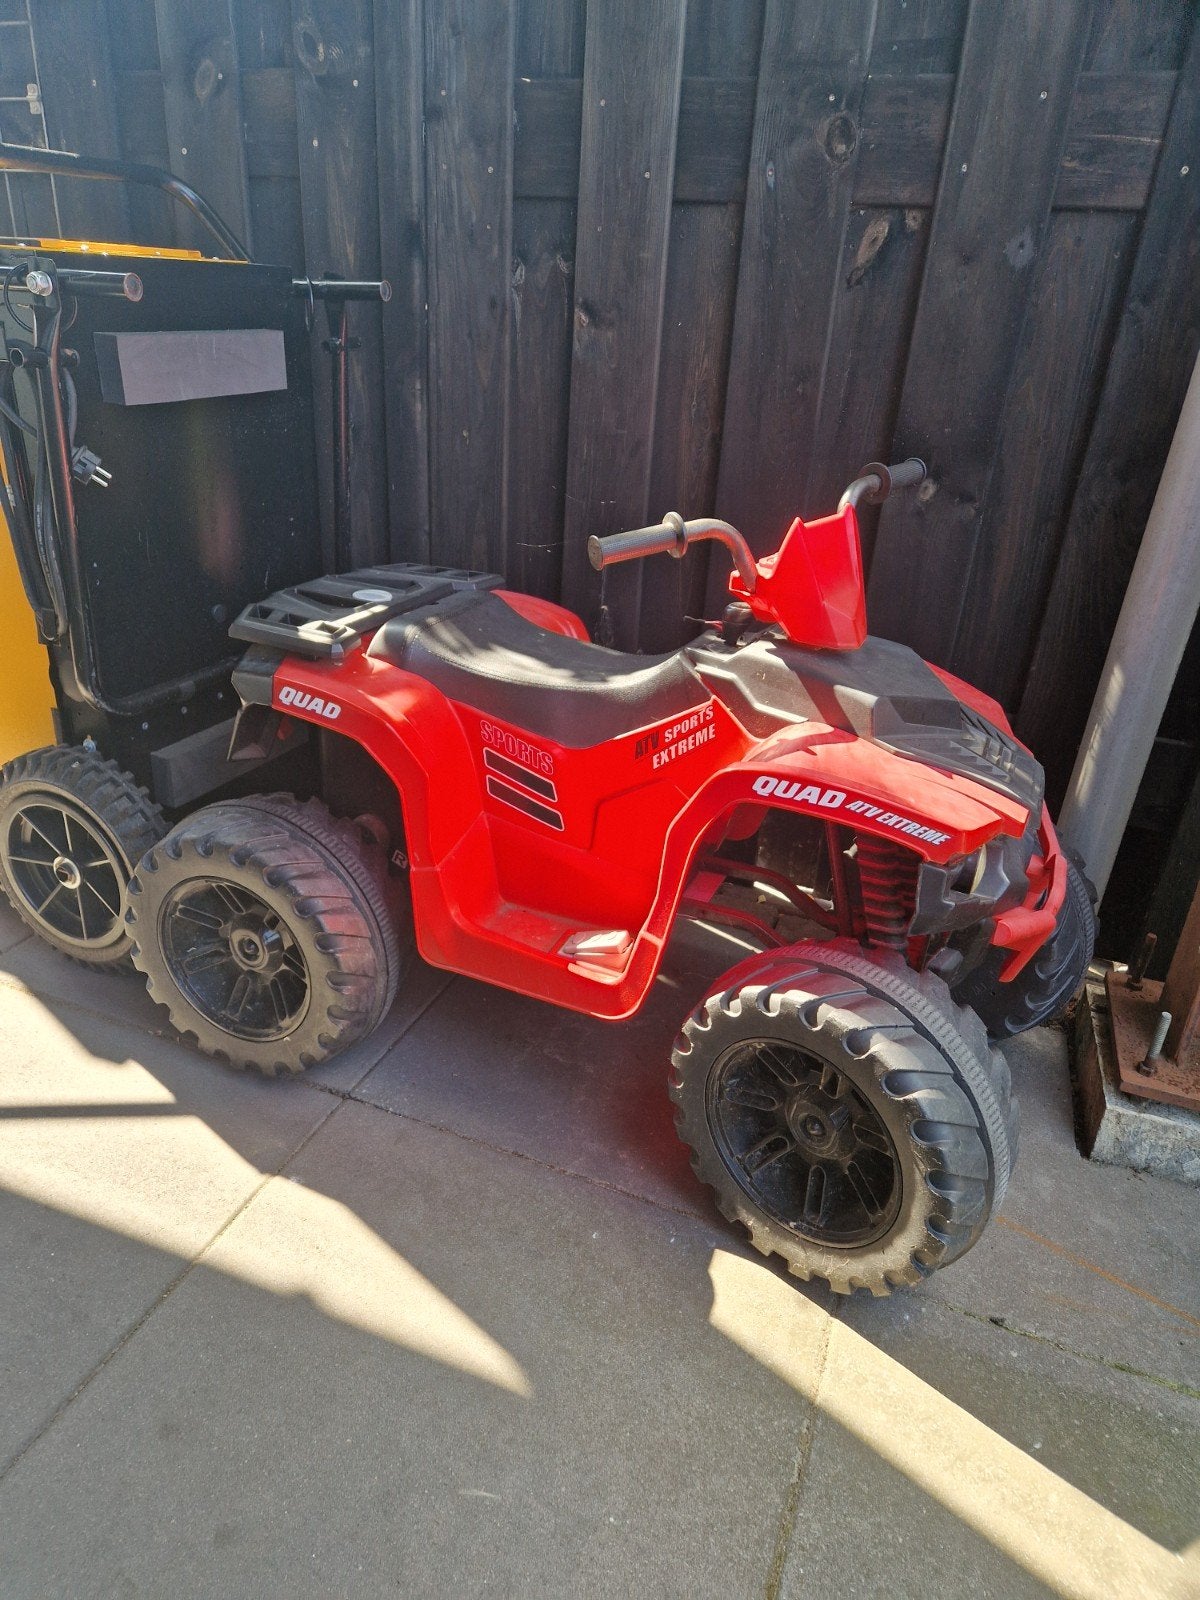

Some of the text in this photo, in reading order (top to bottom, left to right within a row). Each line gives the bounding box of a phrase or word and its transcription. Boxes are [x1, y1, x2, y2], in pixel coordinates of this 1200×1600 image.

[278, 686, 342, 719] QUAD
[480, 720, 554, 775] SPORTS
[634, 705, 715, 760] ATV SPORTS
[652, 724, 716, 770] EXTREME
[752, 775, 951, 845] QUAD ATV EXTREME
